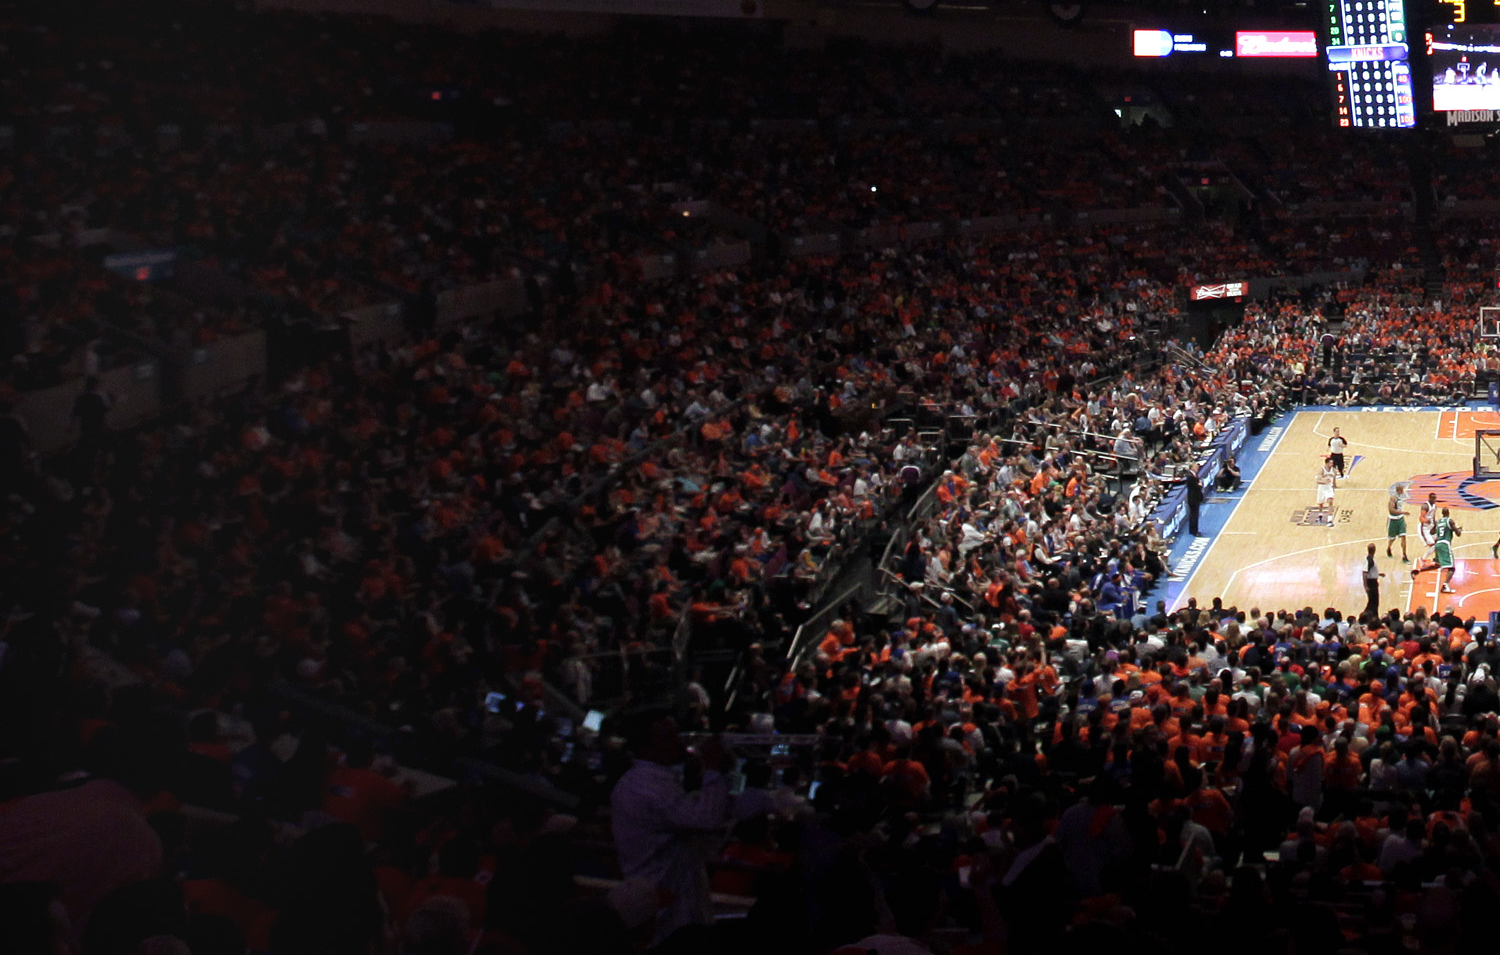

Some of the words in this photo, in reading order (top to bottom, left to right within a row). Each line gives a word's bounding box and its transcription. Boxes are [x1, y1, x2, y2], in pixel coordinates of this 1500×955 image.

[1329, 4, 1335, 12] 7
[1453, 2, 1466, 22] 3
[1330, 16, 1336, 24] 9
[1330, 27, 1340, 35] 20
[1331, 37, 1341, 45] 34
[1351, 47, 1384, 61] KNICKS
[1336, 72, 1342, 81] 1
[1337, 83, 1343, 92] 6
[1339, 95, 1344, 103] 7
[1339, 107, 1348, 115] 14
[1340, 118, 1349, 127] 23
[1447, 110, 1493, 126] MADISON
[1439, 526, 1445, 537] 5
